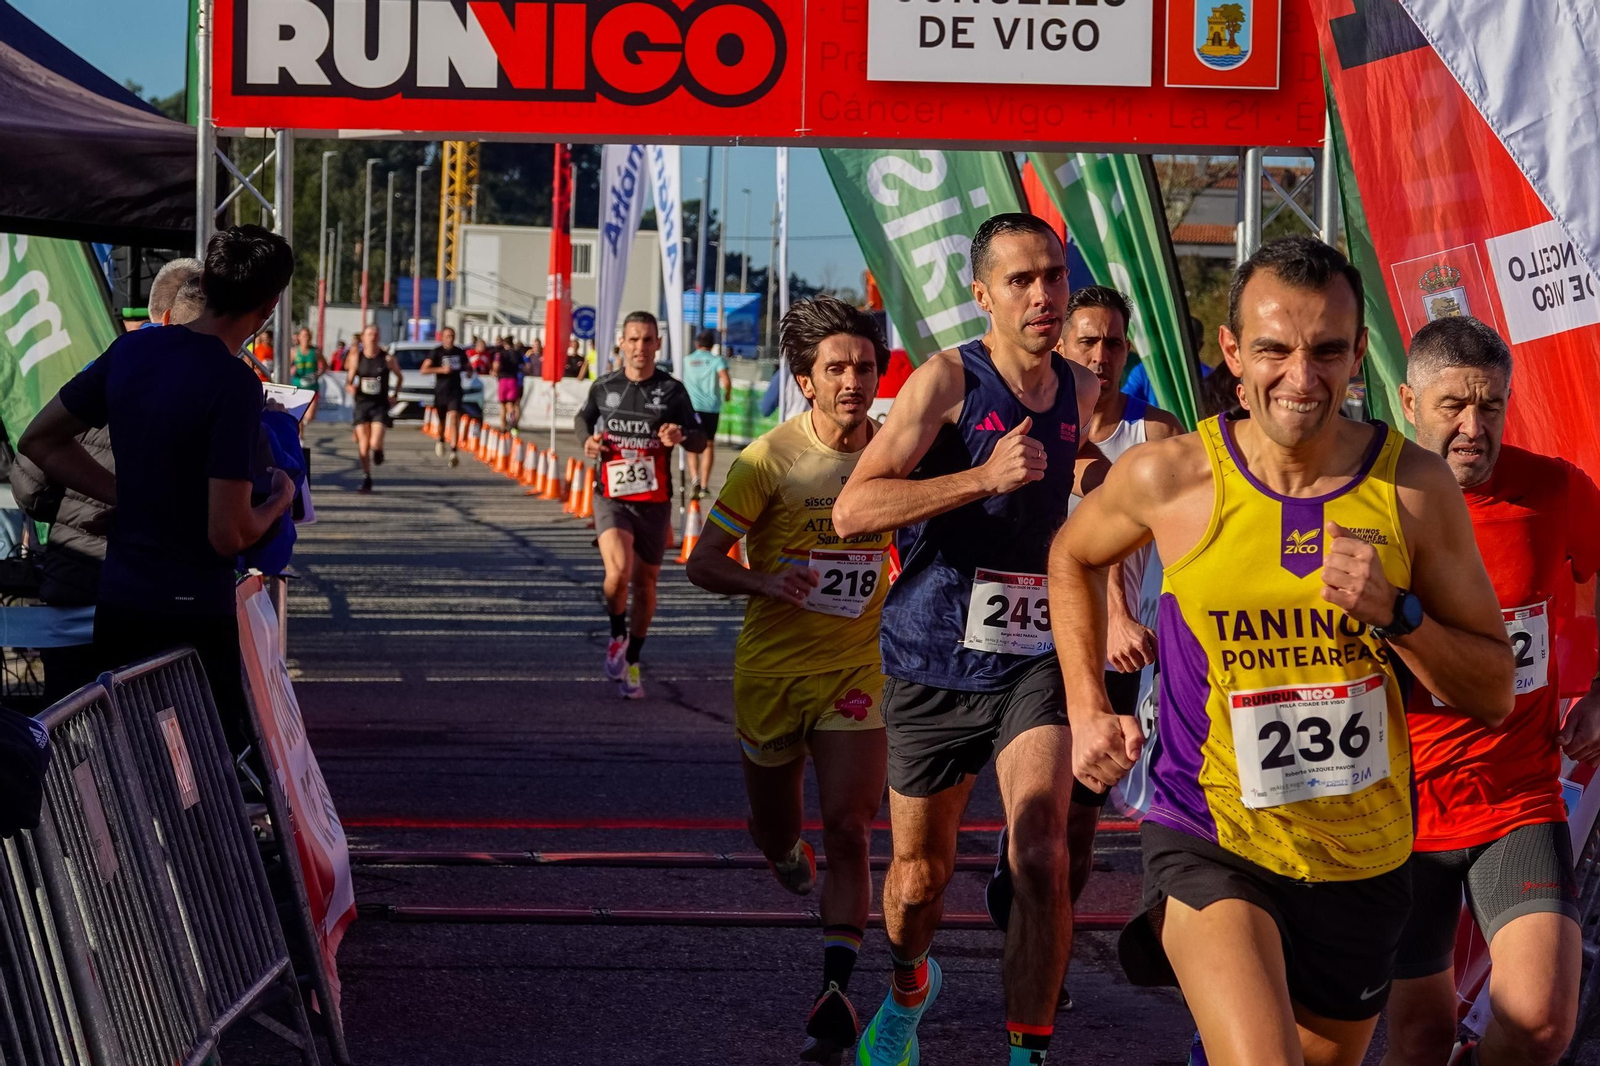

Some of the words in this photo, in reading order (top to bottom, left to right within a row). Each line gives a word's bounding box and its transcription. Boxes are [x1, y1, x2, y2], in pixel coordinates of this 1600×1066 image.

[919, 16, 976, 49] DE
[993, 18, 1101, 52] VIGO
[816, 90, 951, 123] Cáncer
[984, 94, 1065, 133] Vigo
[1169, 102, 1210, 130] La
[1226, 103, 1262, 131] 21
[604, 144, 646, 260] Atlán
[607, 418, 651, 434] GMTA
[615, 467, 648, 485] 233
[816, 532, 839, 545] San
[1284, 544, 1319, 555] ZICO
[1355, 532, 1387, 542] UNNERS
[820, 568, 877, 597] 218
[983, 594, 1052, 632] 243
[1208, 608, 1374, 642] TANINO
[1221, 642, 1390, 672] PONTEAREAS
[1258, 710, 1371, 771] 236
[1284, 769, 1308, 778] Roberto
[1308, 766, 1335, 774] VAZQUEZ
